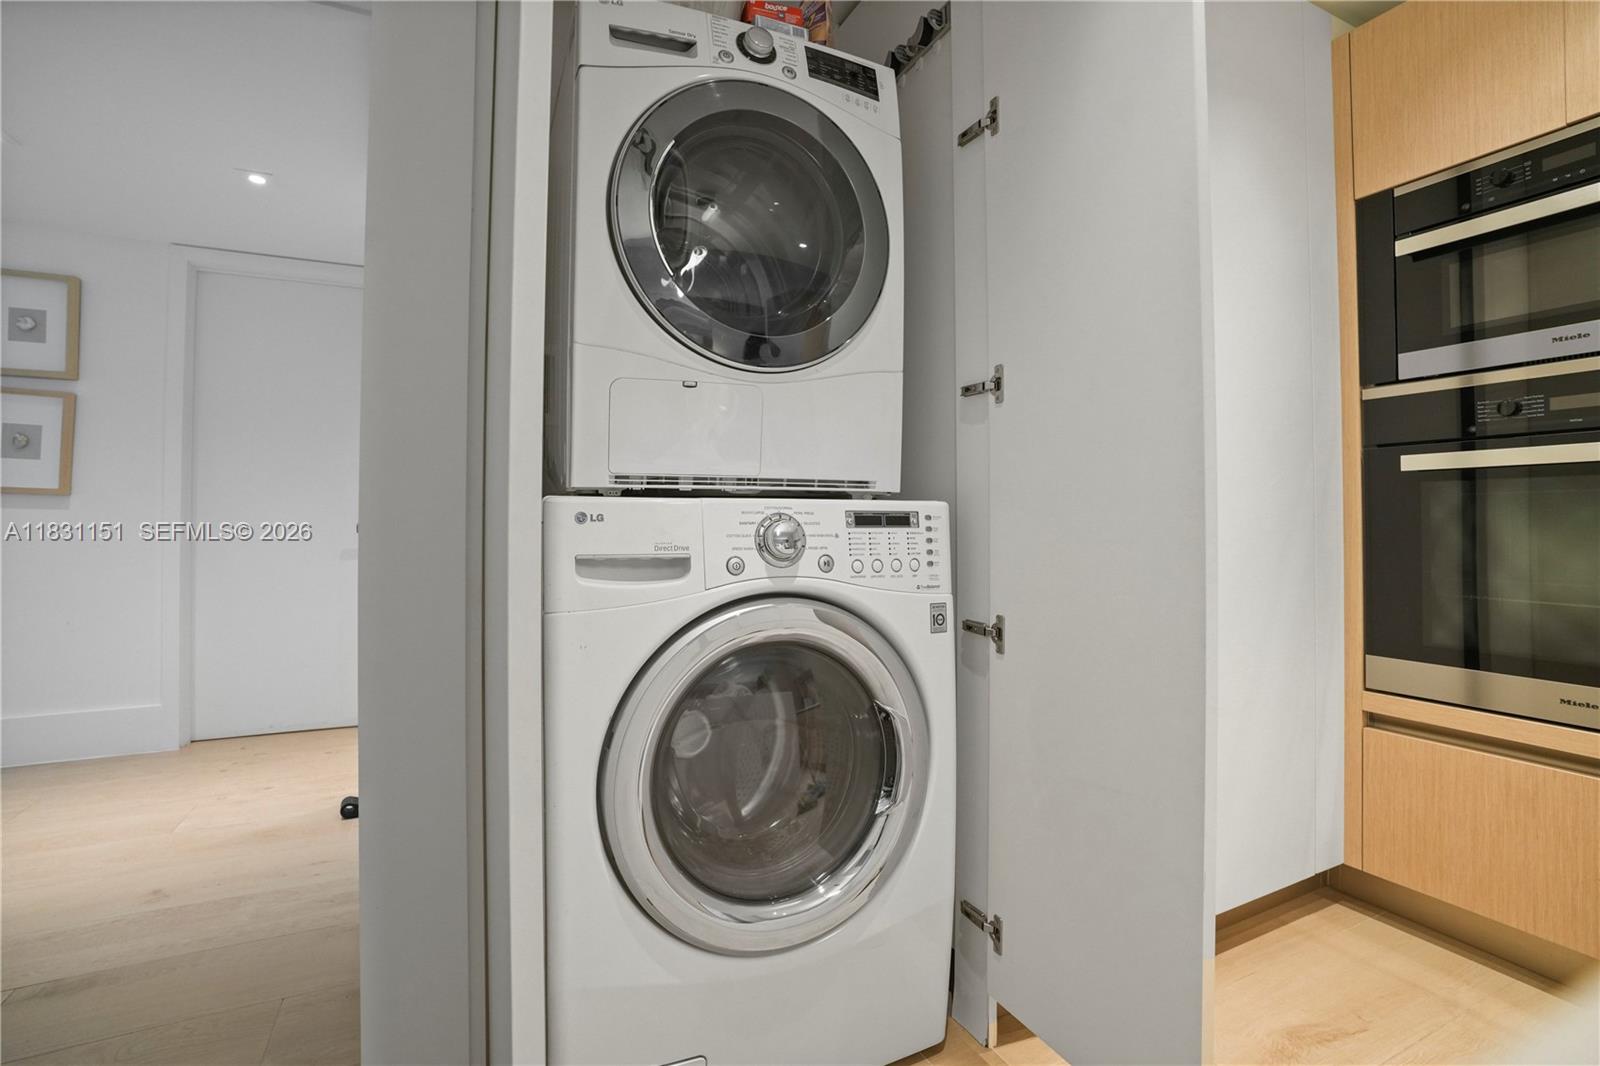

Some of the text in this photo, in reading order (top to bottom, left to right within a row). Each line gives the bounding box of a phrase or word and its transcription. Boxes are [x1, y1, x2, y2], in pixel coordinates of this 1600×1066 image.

[764, 2, 787, 12] bounce
[1552, 333, 1591, 344] Miele
[590, 513, 604, 522] LG
[654, 544, 690, 552] Direct Drive
[932, 612, 945, 627] 10
[1559, 698, 1599, 710] Miele
